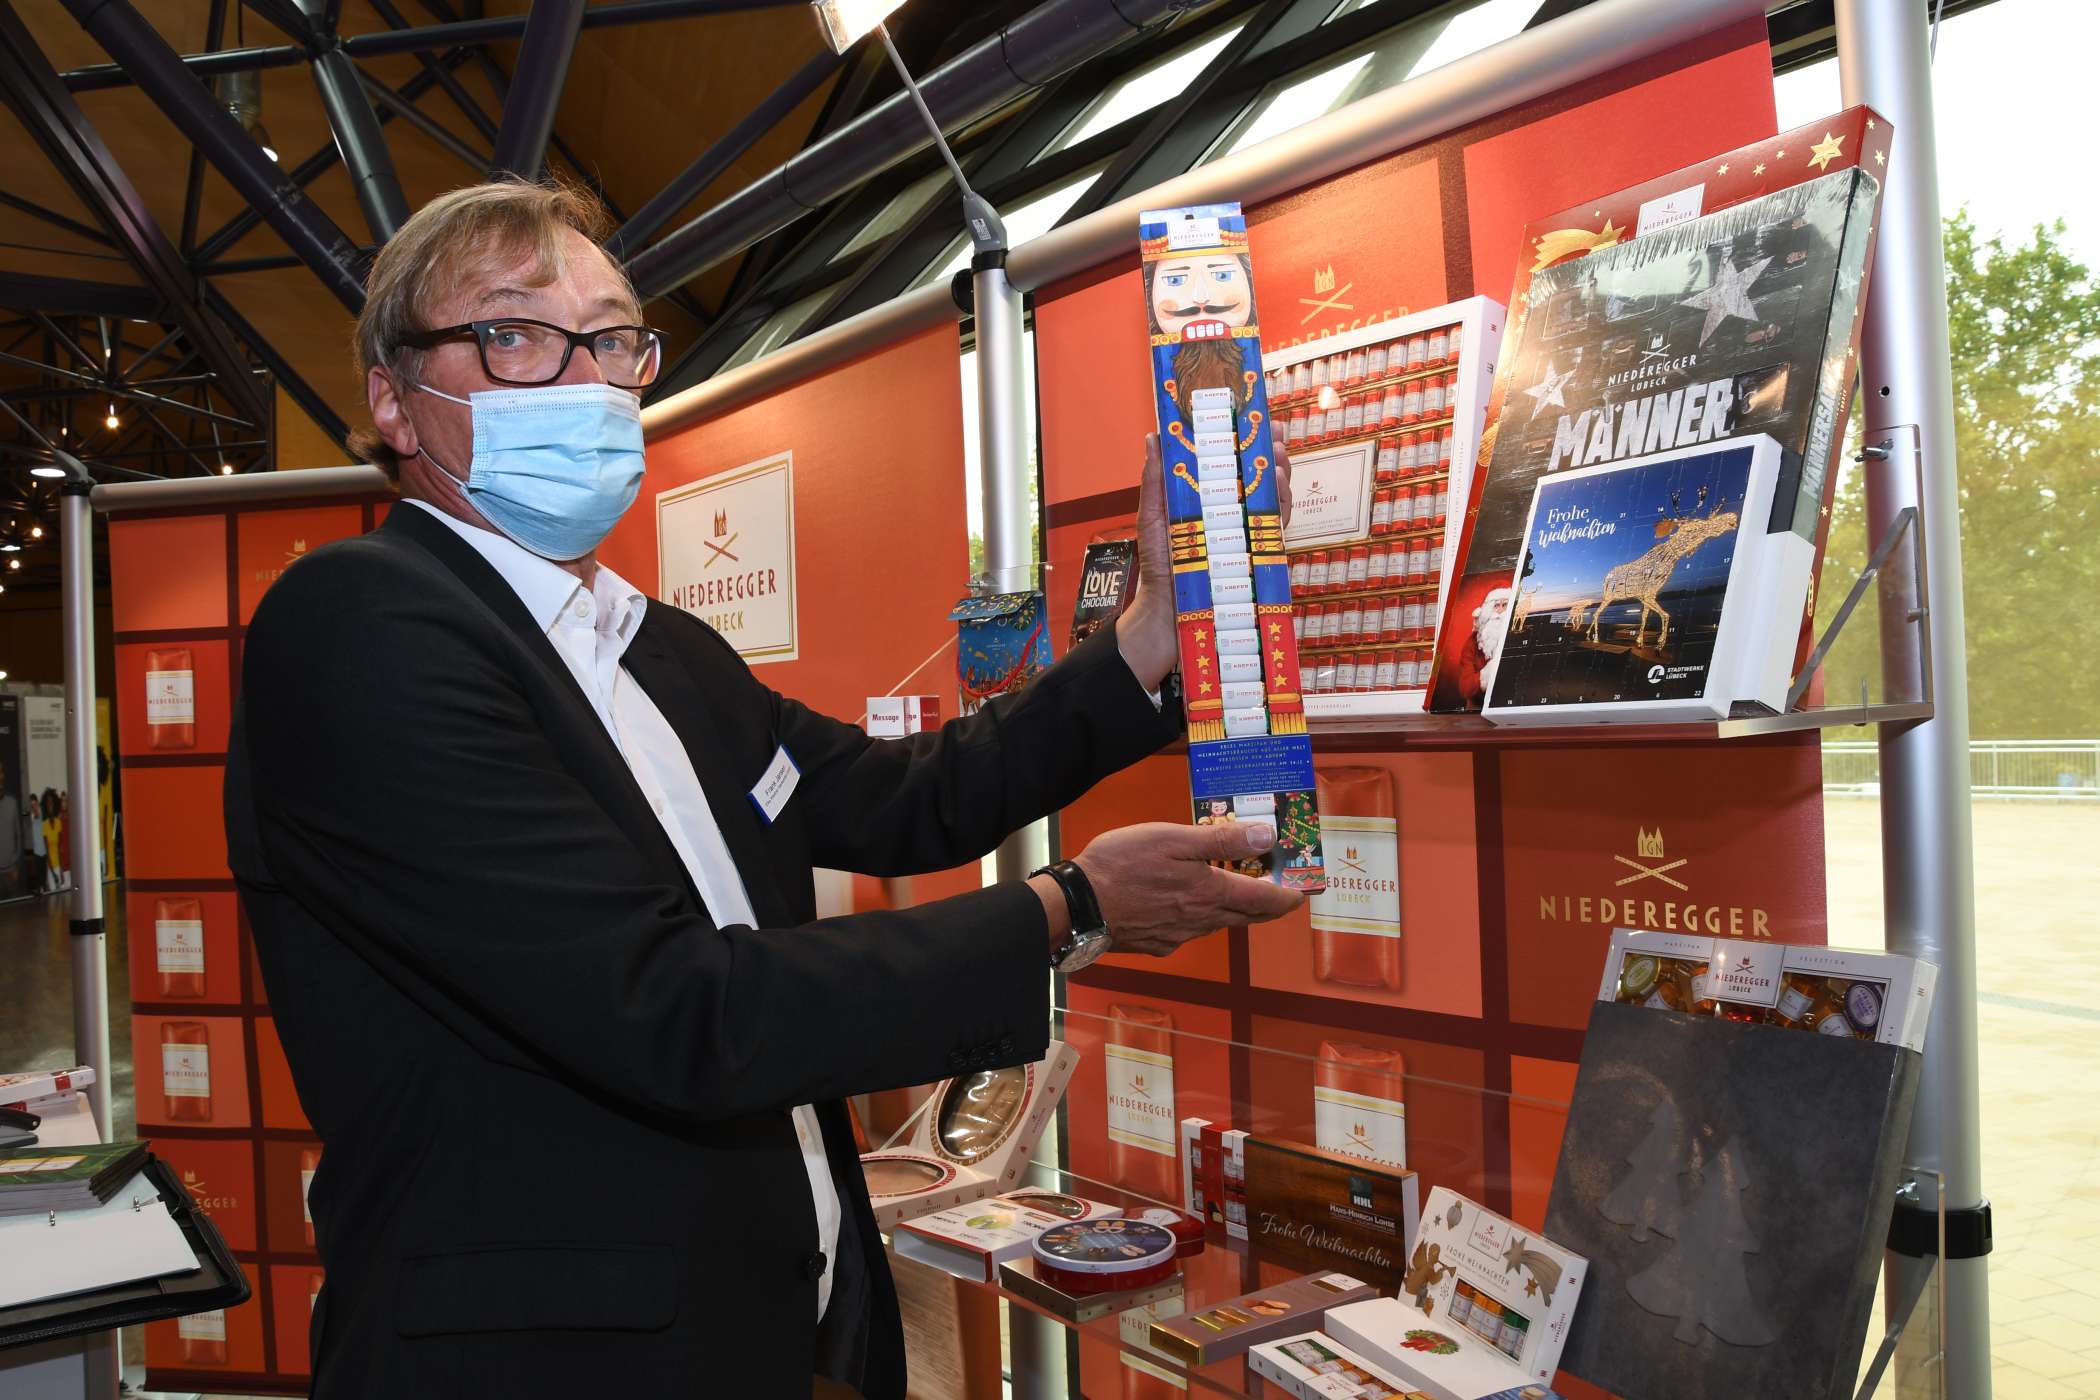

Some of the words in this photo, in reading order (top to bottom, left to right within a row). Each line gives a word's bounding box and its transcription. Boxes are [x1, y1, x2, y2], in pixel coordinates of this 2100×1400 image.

[1607, 354, 1697, 386] NIEDEREGGER
[1547, 377, 1734, 472] MÄNNER
[1547, 505, 1590, 524] Frohe
[1538, 519, 1617, 548] Weihnachten
[673, 568, 777, 609] NIEDEREGGER
[1083, 567, 1123, 598] LOVE
[1667, 665, 1705, 673] STADTWERKE
[872, 713, 899, 722] Message
[1326, 876, 1396, 893] EDEREGGER
[1539, 895, 1772, 937] NIEDEREGGER
[1714, 973, 1770, 988] NIEDEREGGER
[1109, 1095, 1173, 1119] NIEDEREGGER
[1353, 1195, 1373, 1209] HHL
[1259, 1211, 1298, 1240] Frohe
[1300, 1224, 1392, 1268] Weihnachten
